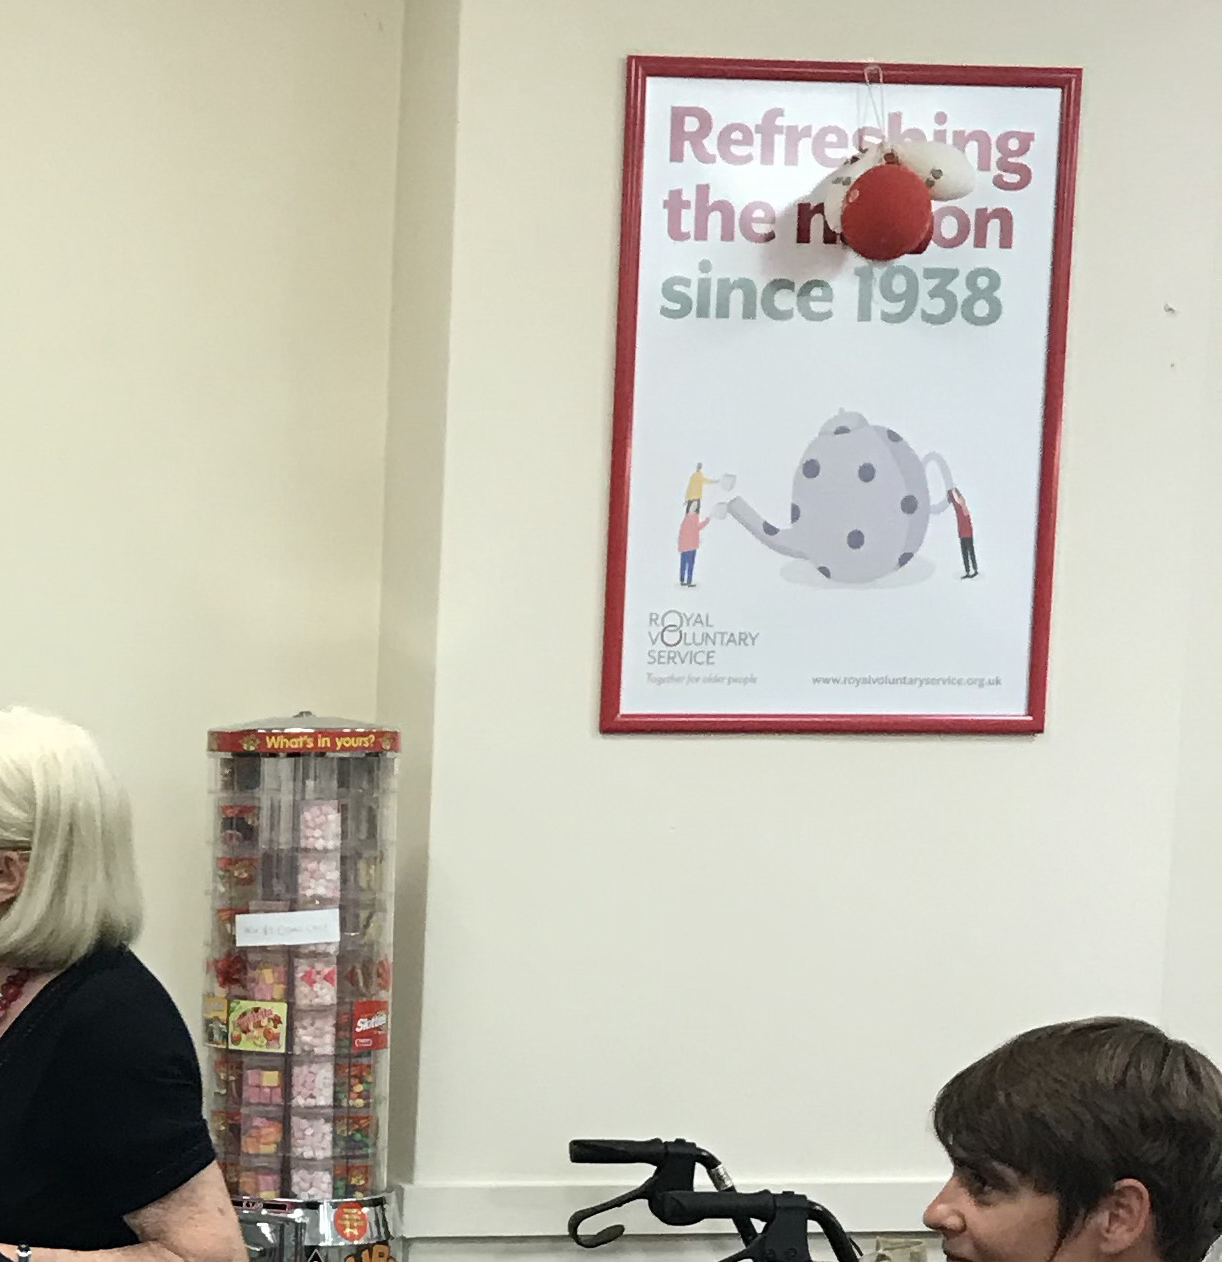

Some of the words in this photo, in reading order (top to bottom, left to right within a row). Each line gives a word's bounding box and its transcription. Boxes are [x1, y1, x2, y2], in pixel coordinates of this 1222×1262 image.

[669, 105, 1036, 191] Refreshing
[663, 183, 776, 243] the
[795, 200, 1014, 254] non
[659, 258, 834, 322] since
[853, 264, 1003, 327] 1938
[649, 610, 715, 632] ROYAL
[647, 624, 760, 648] VOLUNTARY
[646, 649, 716, 665] SERVICE
[646, 672, 686, 686] Together
[811, 674, 1003, 689] www.royalvoluntaryservice.org.uk
[265, 734, 315, 749] What's
[317, 733, 331, 748] in
[335, 734, 376, 751] yours?
